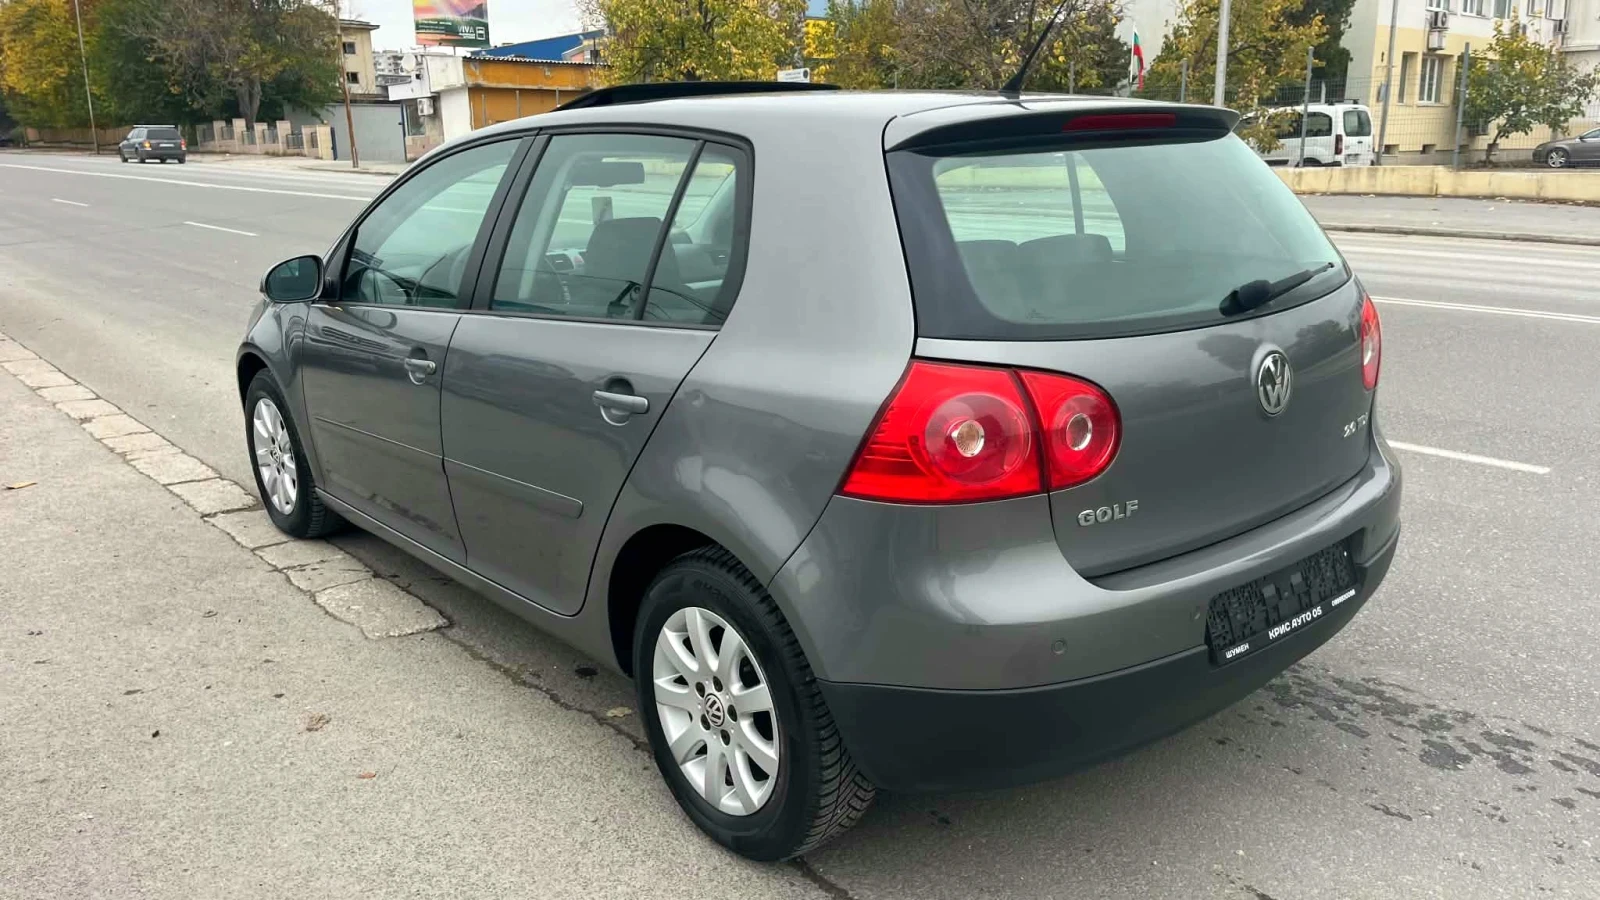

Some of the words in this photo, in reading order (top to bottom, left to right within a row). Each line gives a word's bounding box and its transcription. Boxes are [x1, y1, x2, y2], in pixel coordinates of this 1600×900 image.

[458, 25, 474, 33] VIVA
[1258, 353, 1291, 414] VW
[1077, 499, 1139, 527] GOLF
[1225, 642, 1250, 659] ШУМЕН
[1268, 621, 1291, 640] КРИС
[1291, 611, 1312, 629] АУТО
[1312, 605, 1322, 618] 05
